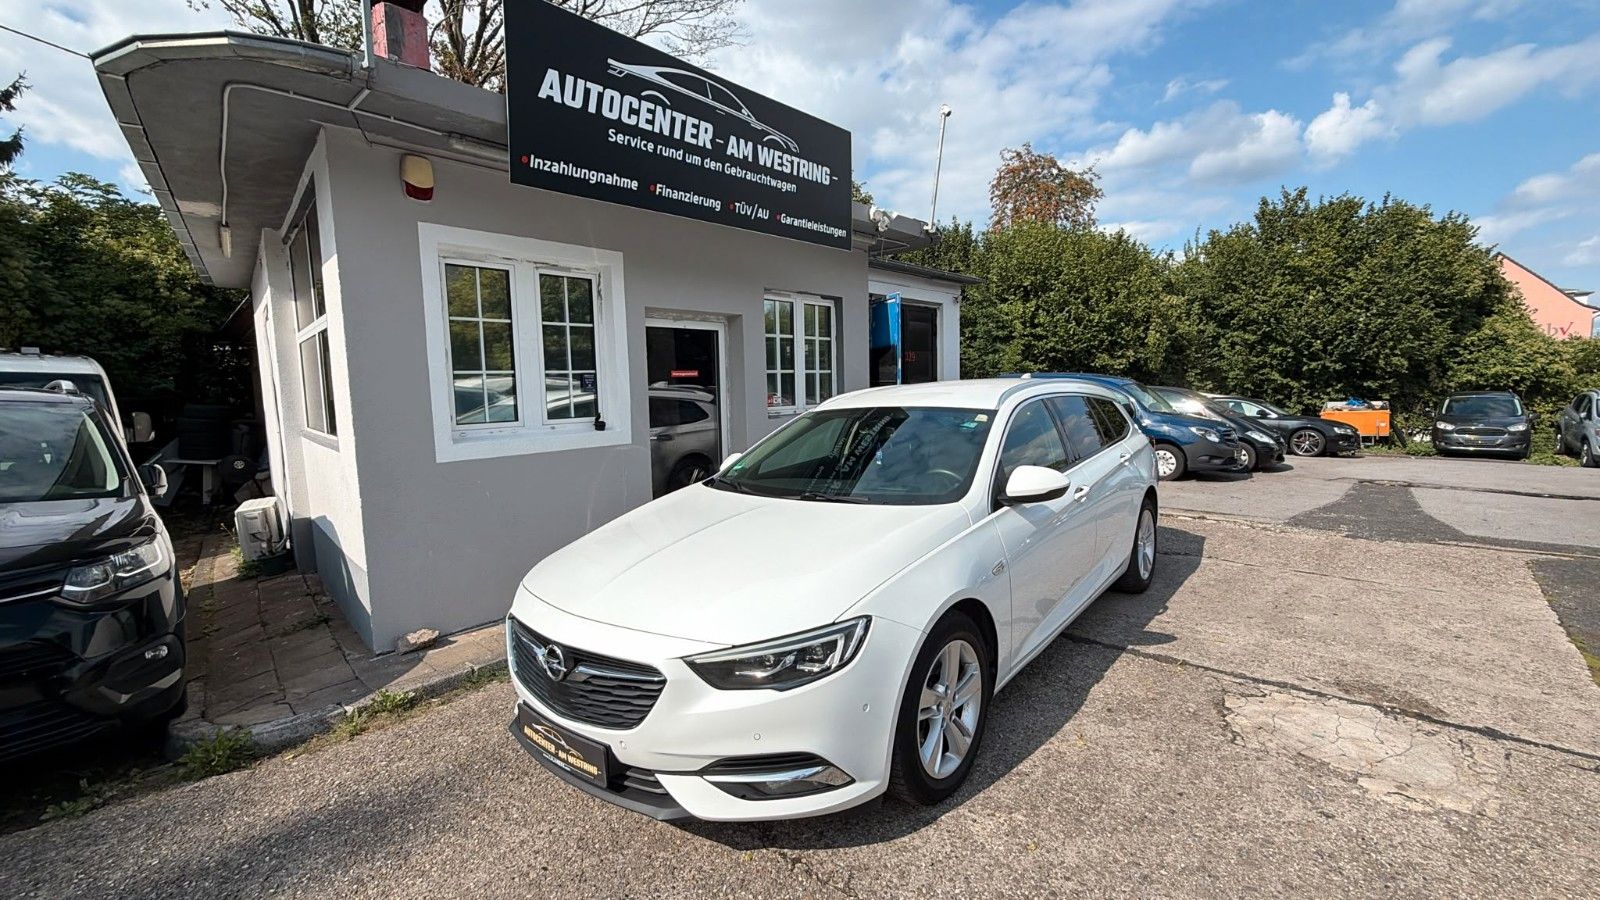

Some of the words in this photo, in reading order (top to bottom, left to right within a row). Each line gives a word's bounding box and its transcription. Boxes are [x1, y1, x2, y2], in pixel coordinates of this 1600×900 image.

[538, 68, 713, 149] AUTOCENTER
[726, 135, 753, 162] AM
[757, 144, 831, 185] WESTRING
[608, 128, 654, 152] Service
[657, 144, 683, 161] rund
[685, 152, 702, 166] um
[703, 158, 723, 172] den
[724, 163, 797, 193] Gebrauchtwagen
[529, 154, 639, 191] Inzahlungnahme
[655, 183, 722, 212] Finanzierung
[735, 201, 770, 220] TÜV/AU
[780, 213, 847, 238] Garantieleistungen
[524, 725, 556, 754] AUTOCENTER
[567, 754, 598, 776] WESTRING
